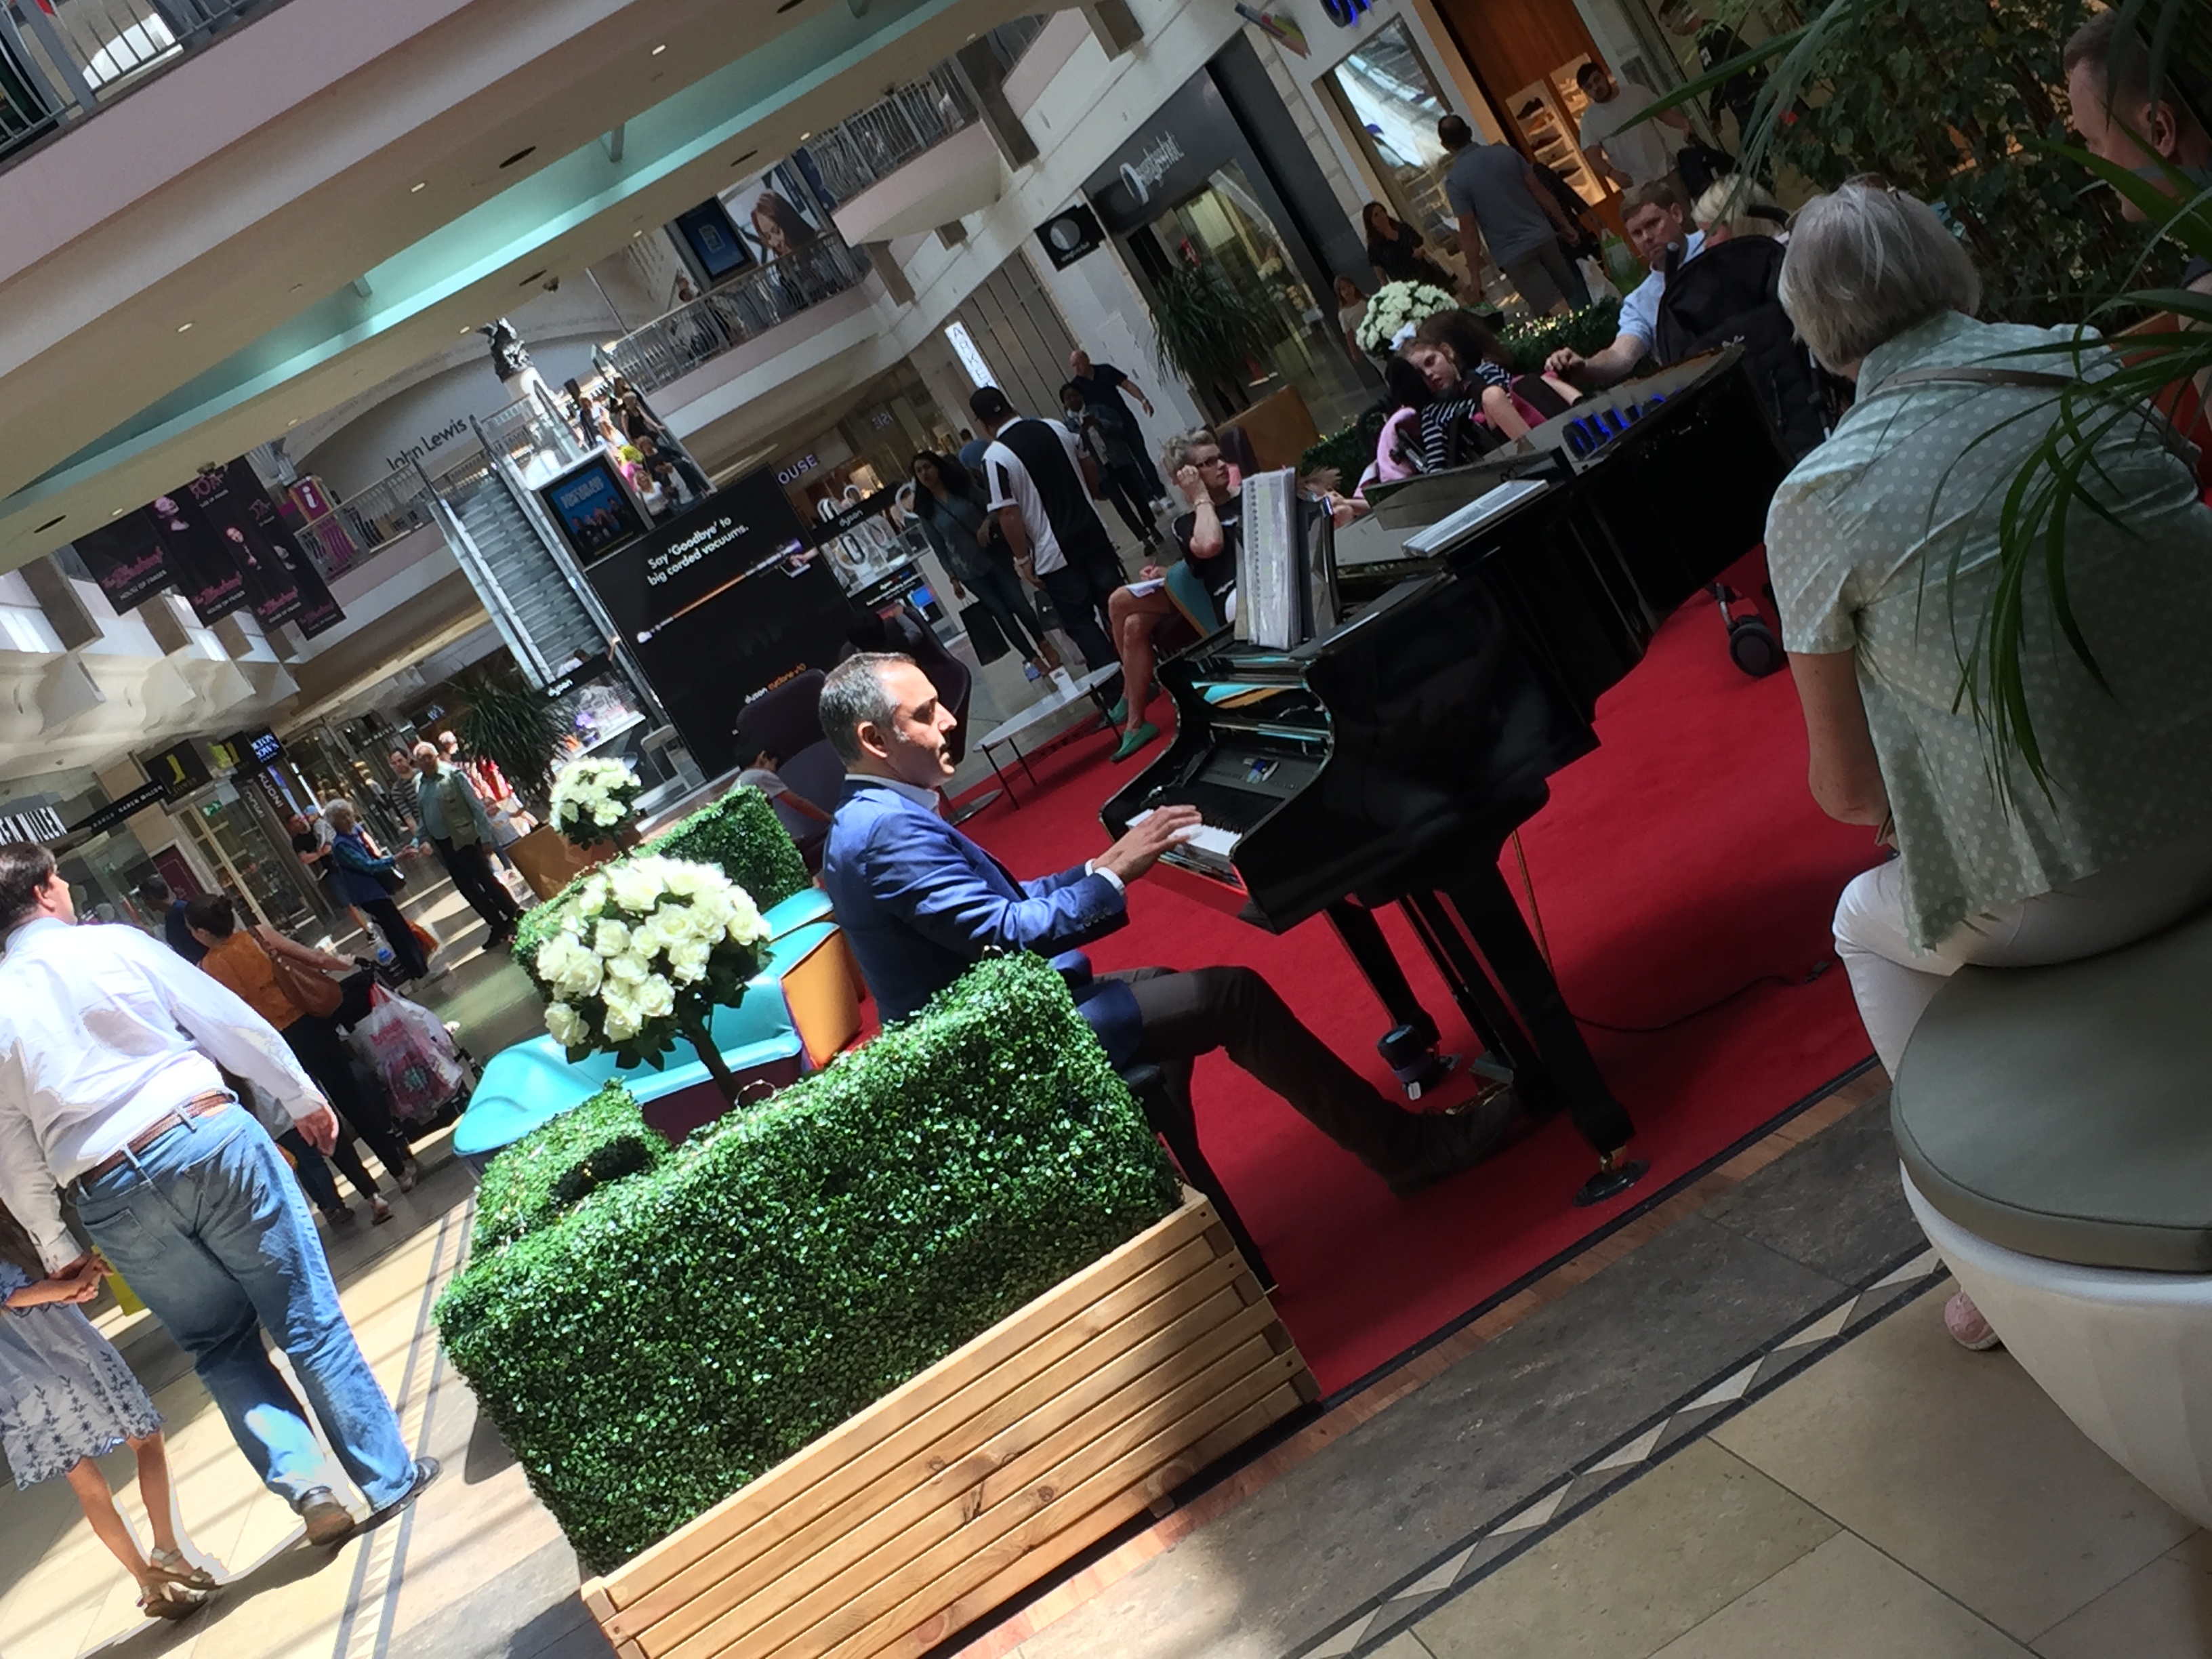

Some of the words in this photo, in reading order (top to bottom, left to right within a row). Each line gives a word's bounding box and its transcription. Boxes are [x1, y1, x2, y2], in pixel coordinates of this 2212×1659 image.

[386, 445, 425, 471] John
[420, 418, 468, 452] Lewis
[647, 553, 669, 570] Say
[719, 516, 732, 528] to
[647, 571, 668, 586] big
[666, 547, 703, 575] corded
[701, 525, 750, 555] vacuums.
[745, 687, 769, 704] dyson
[258, 771, 285, 808] KUONI
[15, 805, 68, 845] MILLEN
